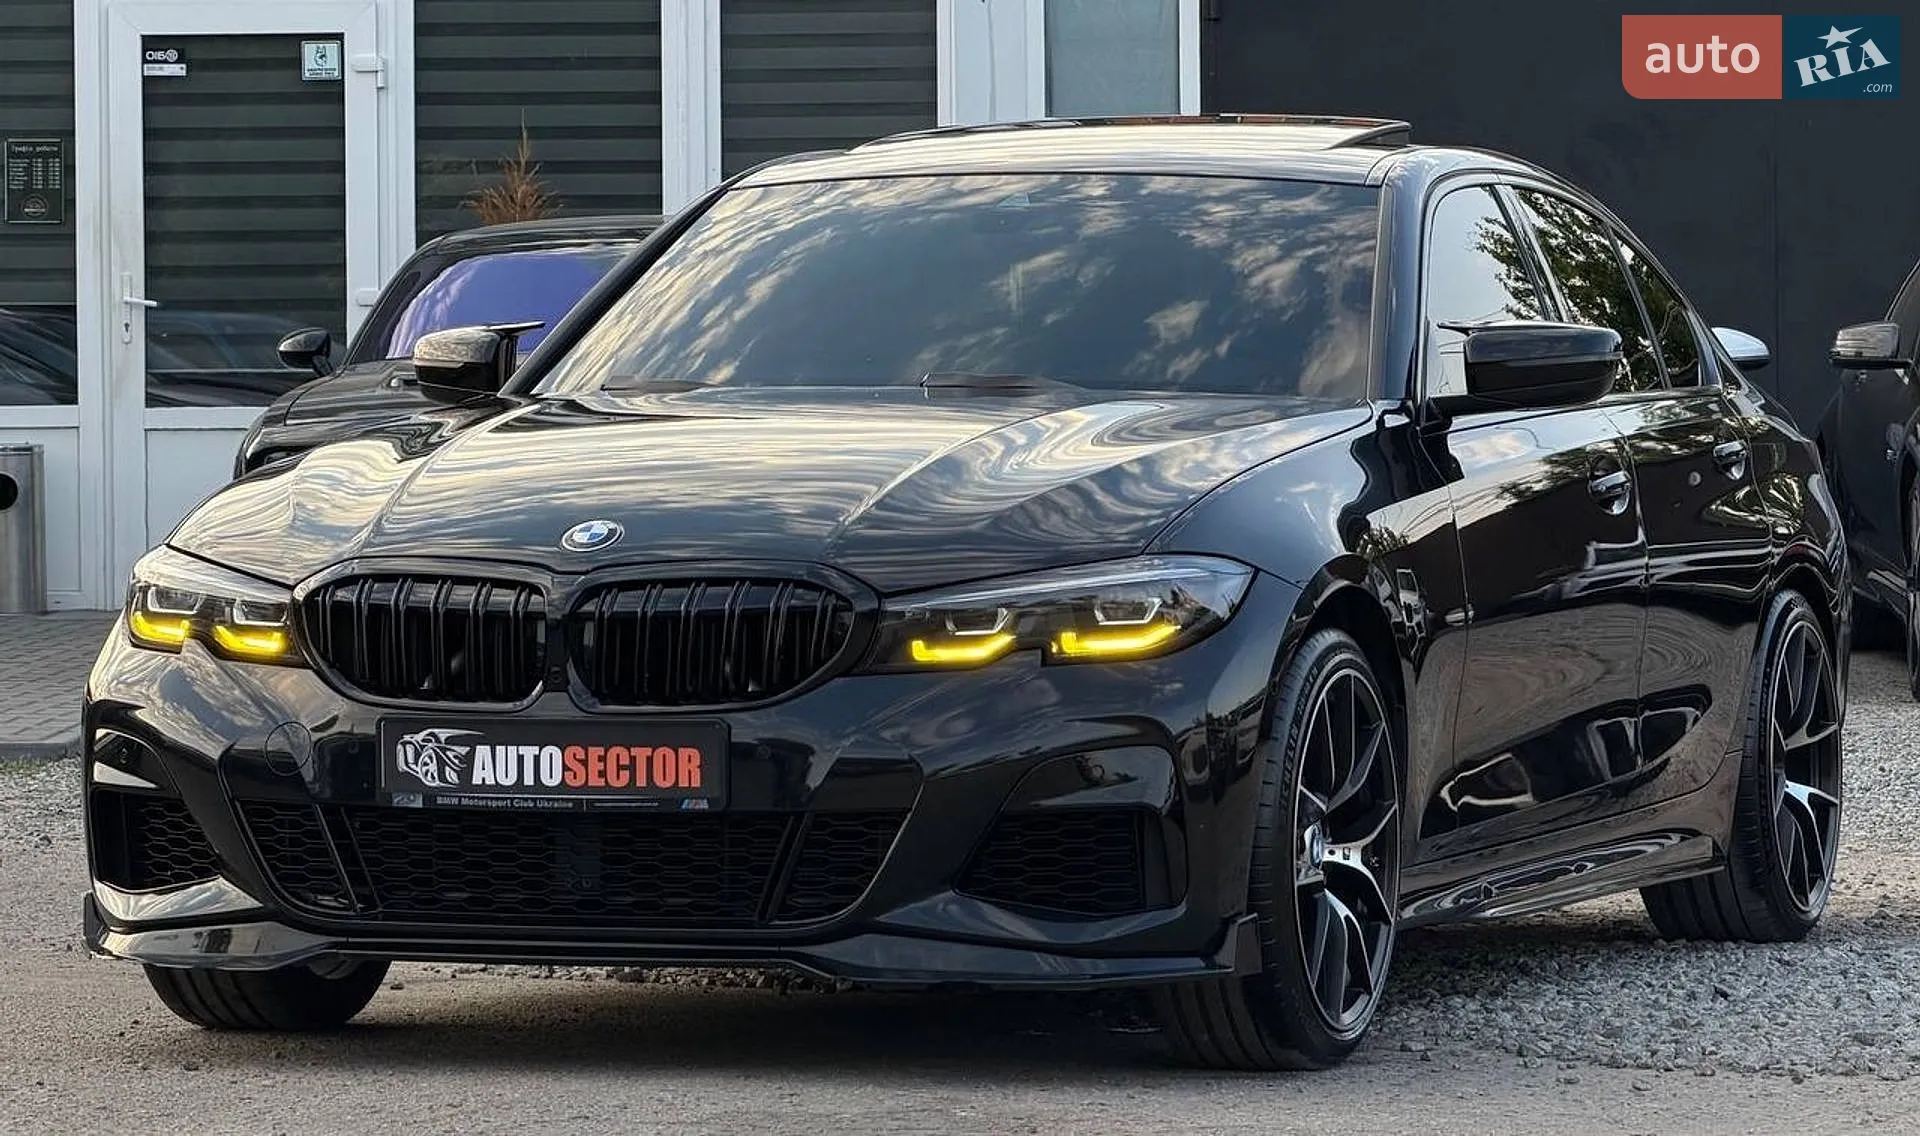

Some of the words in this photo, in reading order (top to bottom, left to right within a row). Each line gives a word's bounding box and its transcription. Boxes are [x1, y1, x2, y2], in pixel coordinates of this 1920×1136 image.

[471, 744, 701, 788] AUTOSECTOR
[436, 795, 459, 805] BMW
[461, 796, 511, 808] Motorsport
[513, 797, 534, 807] Club
[537, 798, 573, 808] Ukraine
